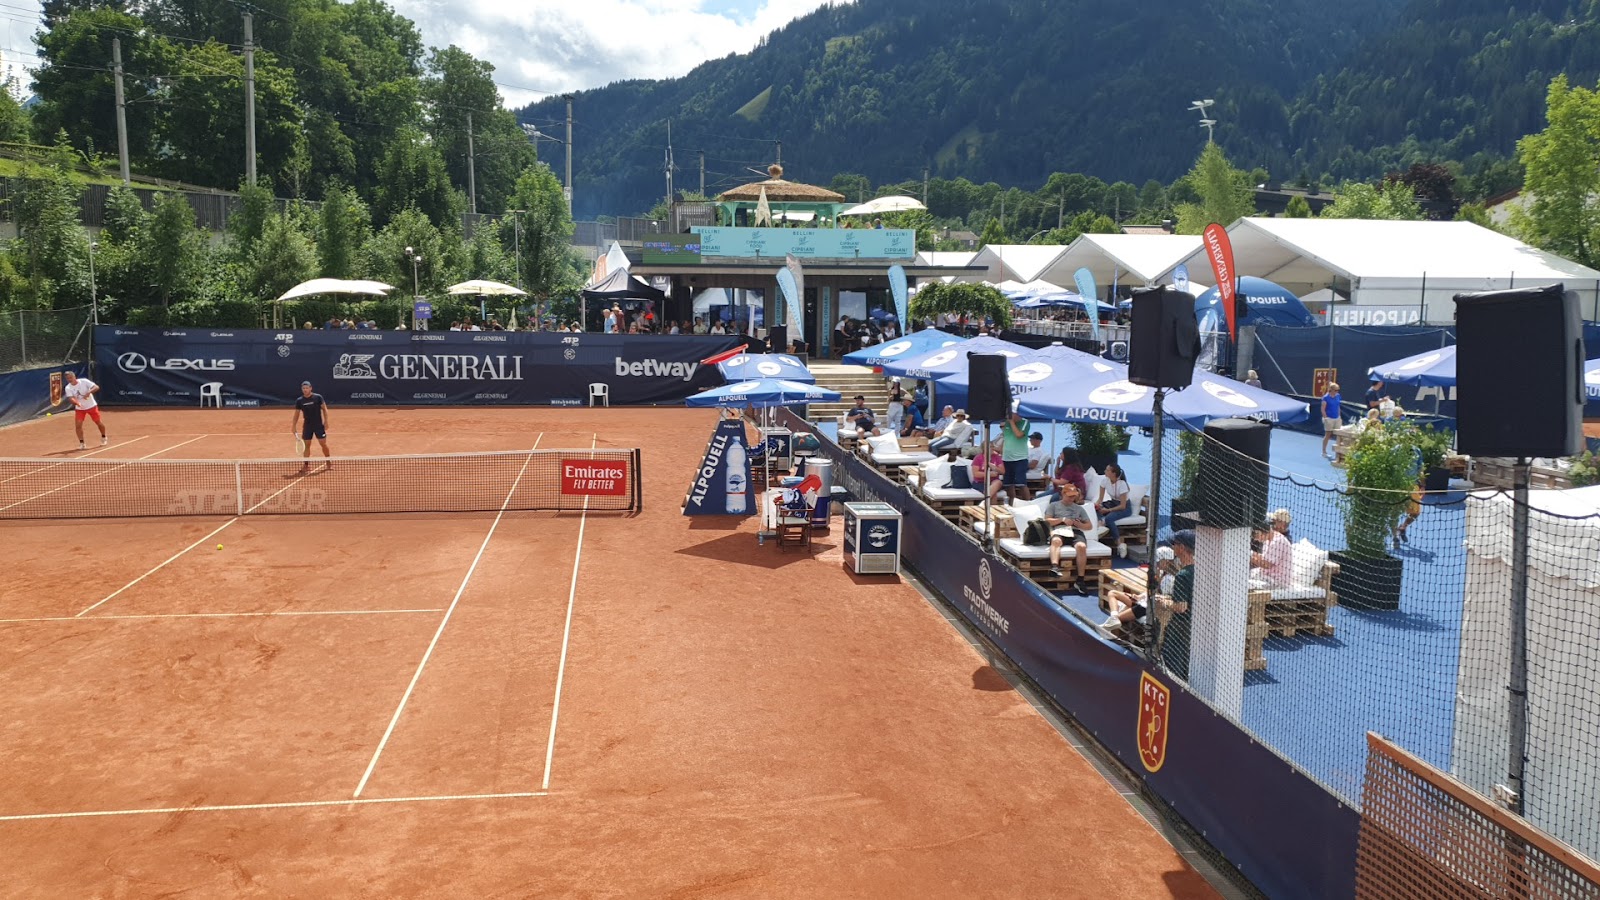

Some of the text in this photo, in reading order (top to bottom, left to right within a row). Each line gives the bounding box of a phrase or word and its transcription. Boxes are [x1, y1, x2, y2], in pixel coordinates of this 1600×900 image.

[1246, 296, 1288, 304] LPQUELL
[274, 333, 293, 341] ATP
[150, 358, 235, 371] LEXUS
[379, 354, 524, 381] GENERALI
[615, 356, 698, 382] betway
[905, 369, 931, 378] ALPQUELL
[1065, 407, 1129, 422] ALPQUELL
[565, 465, 624, 479] Emirates
[691, 435, 728, 507] ALPQUELL
[573, 479, 615, 490] FLY BETTER
[167, 488, 327, 511] ATP TOUR
[963, 584, 1010, 635] STADTWERKE
[1144, 681, 1165, 707] KTC
